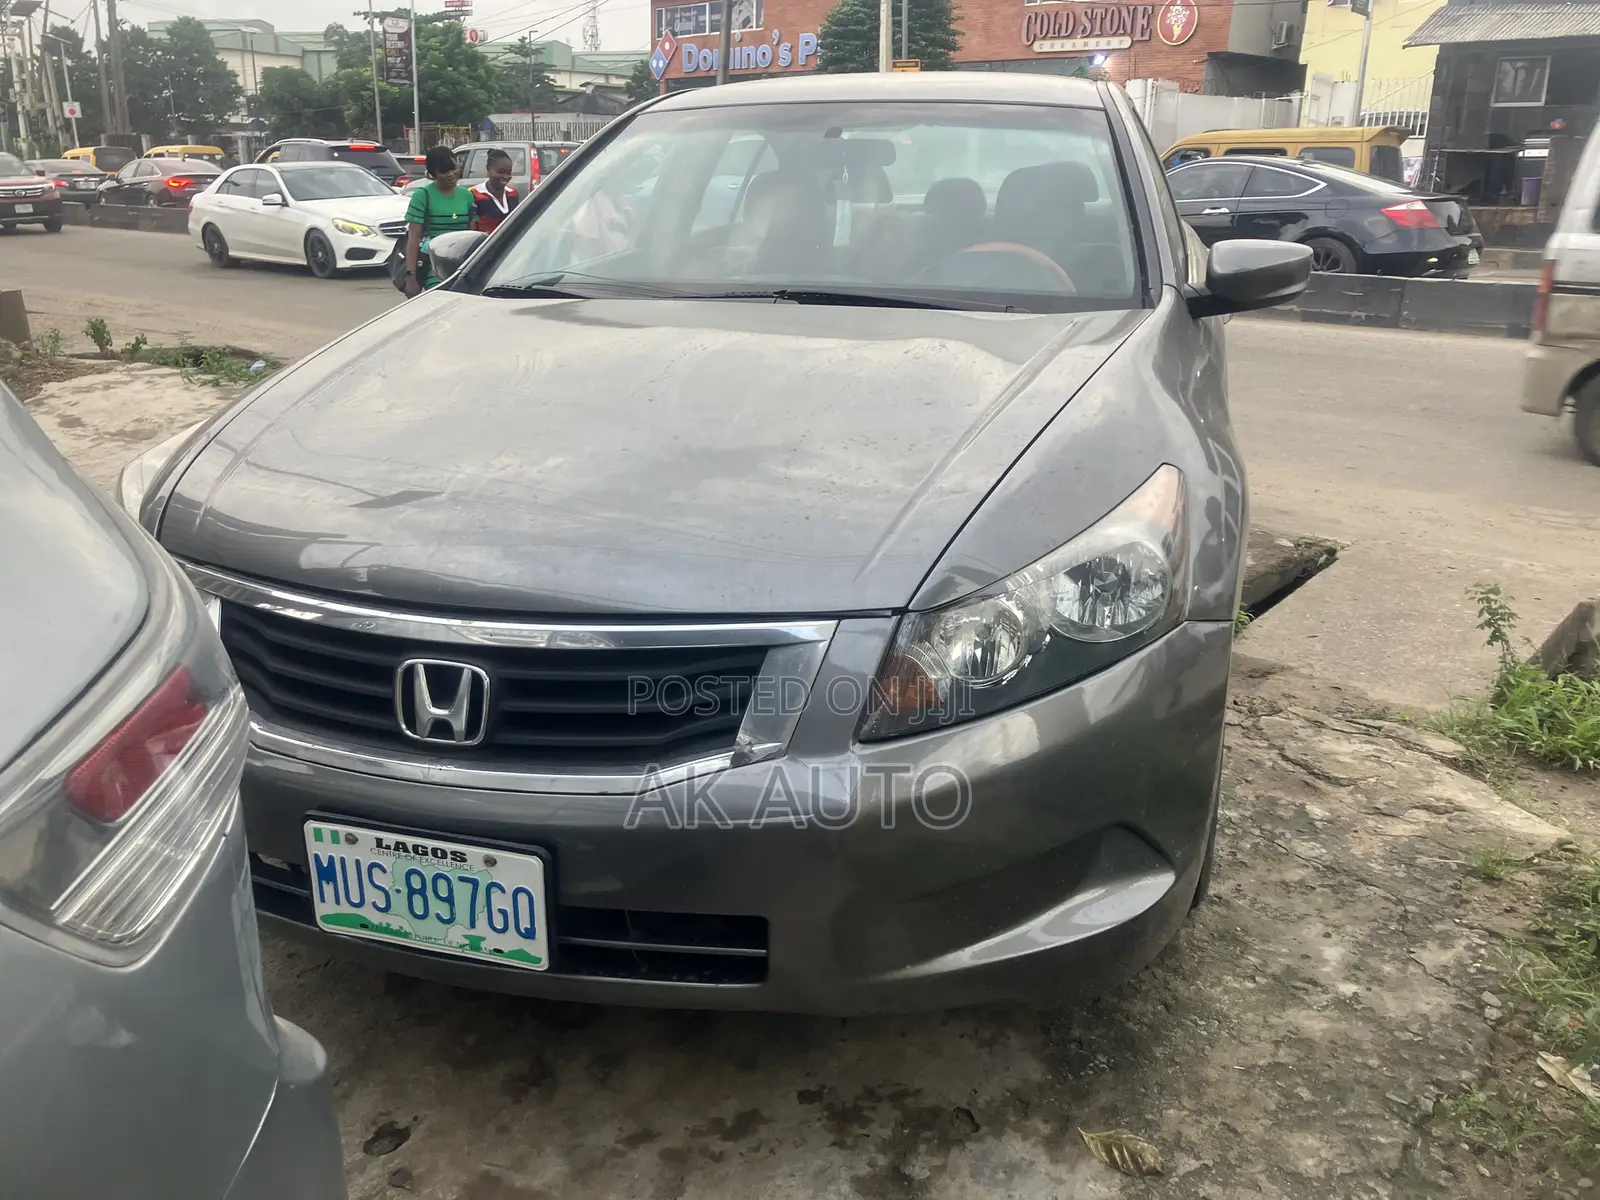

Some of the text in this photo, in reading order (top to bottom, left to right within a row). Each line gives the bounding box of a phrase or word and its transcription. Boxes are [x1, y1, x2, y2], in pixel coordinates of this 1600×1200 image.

[1022, 5, 1153, 46] COLD STONE
[1039, 39, 1124, 49] CREAMERY
[370, 847, 403, 860] CENTRE
[374, 837, 468, 863] LAGOS
